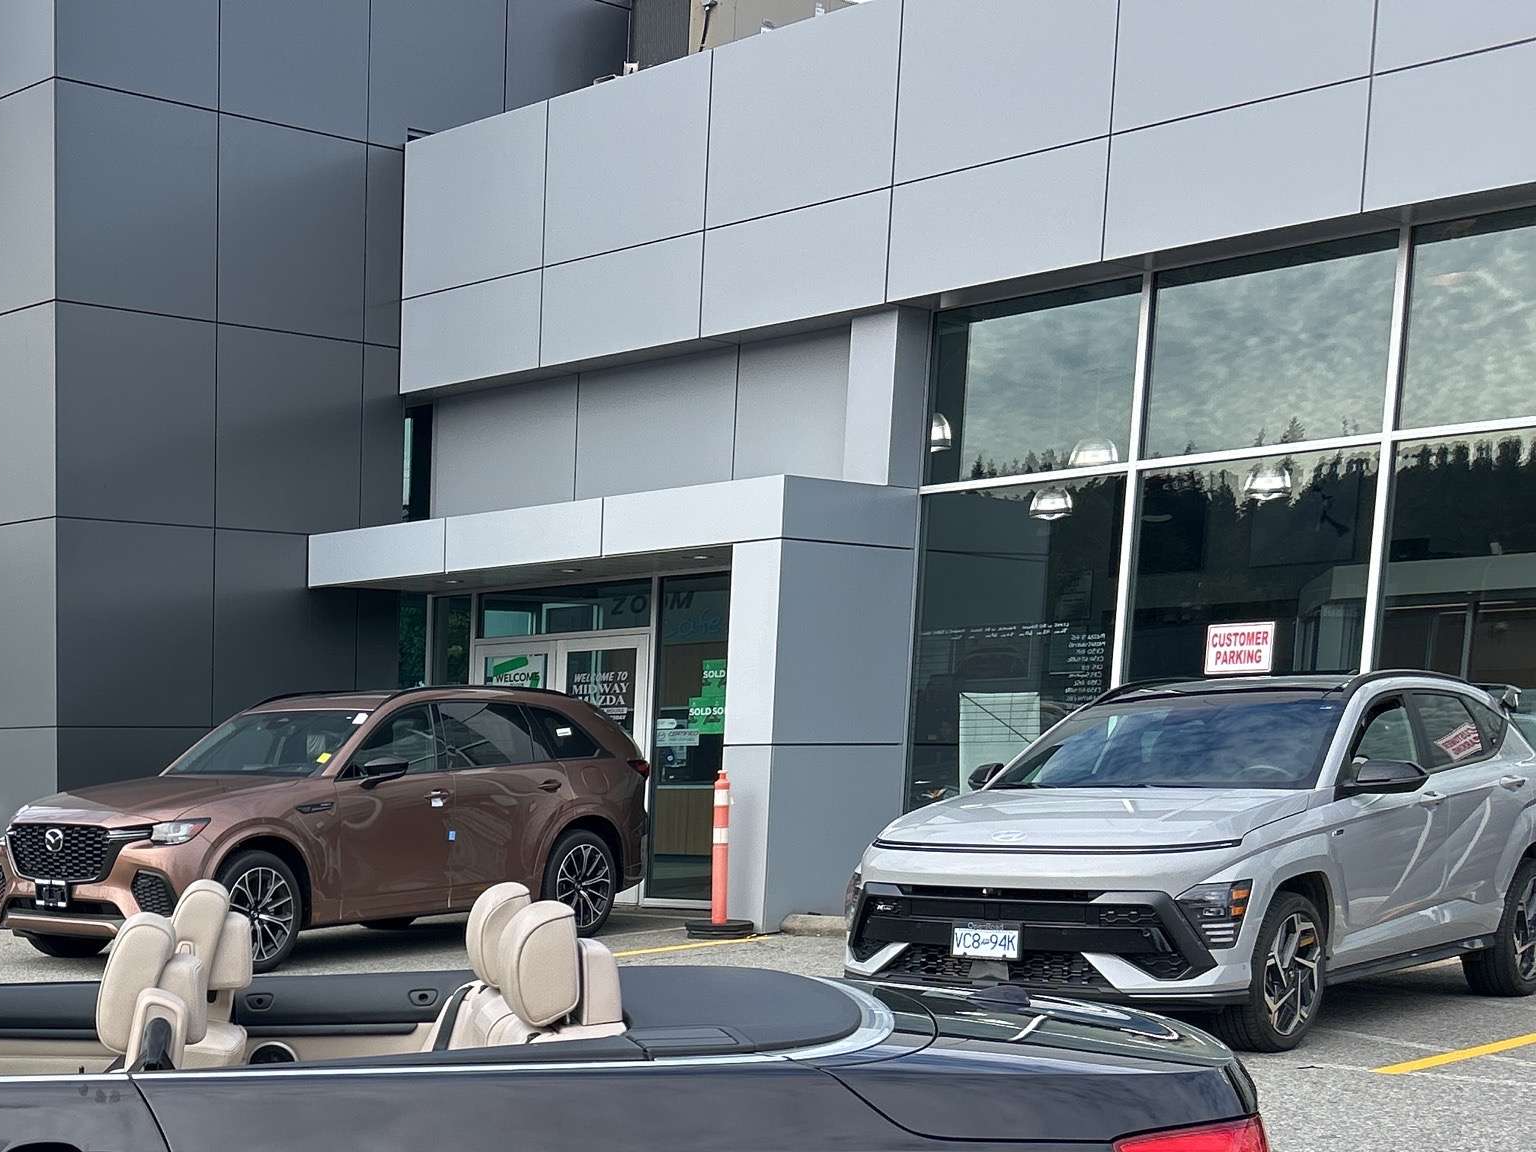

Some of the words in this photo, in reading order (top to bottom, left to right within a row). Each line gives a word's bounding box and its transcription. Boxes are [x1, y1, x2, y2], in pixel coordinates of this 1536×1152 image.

[1211, 631, 1269, 648] CUSTOMER
[1215, 649, 1263, 665] PARKING
[495, 671, 541, 683] WELCOME
[574, 672, 615, 683] WELCOME
[617, 671, 628, 681] TO
[703, 670, 726, 679] SOLD
[572, 682, 630, 695] MIDWAY
[689, 707, 711, 716] SOLD
